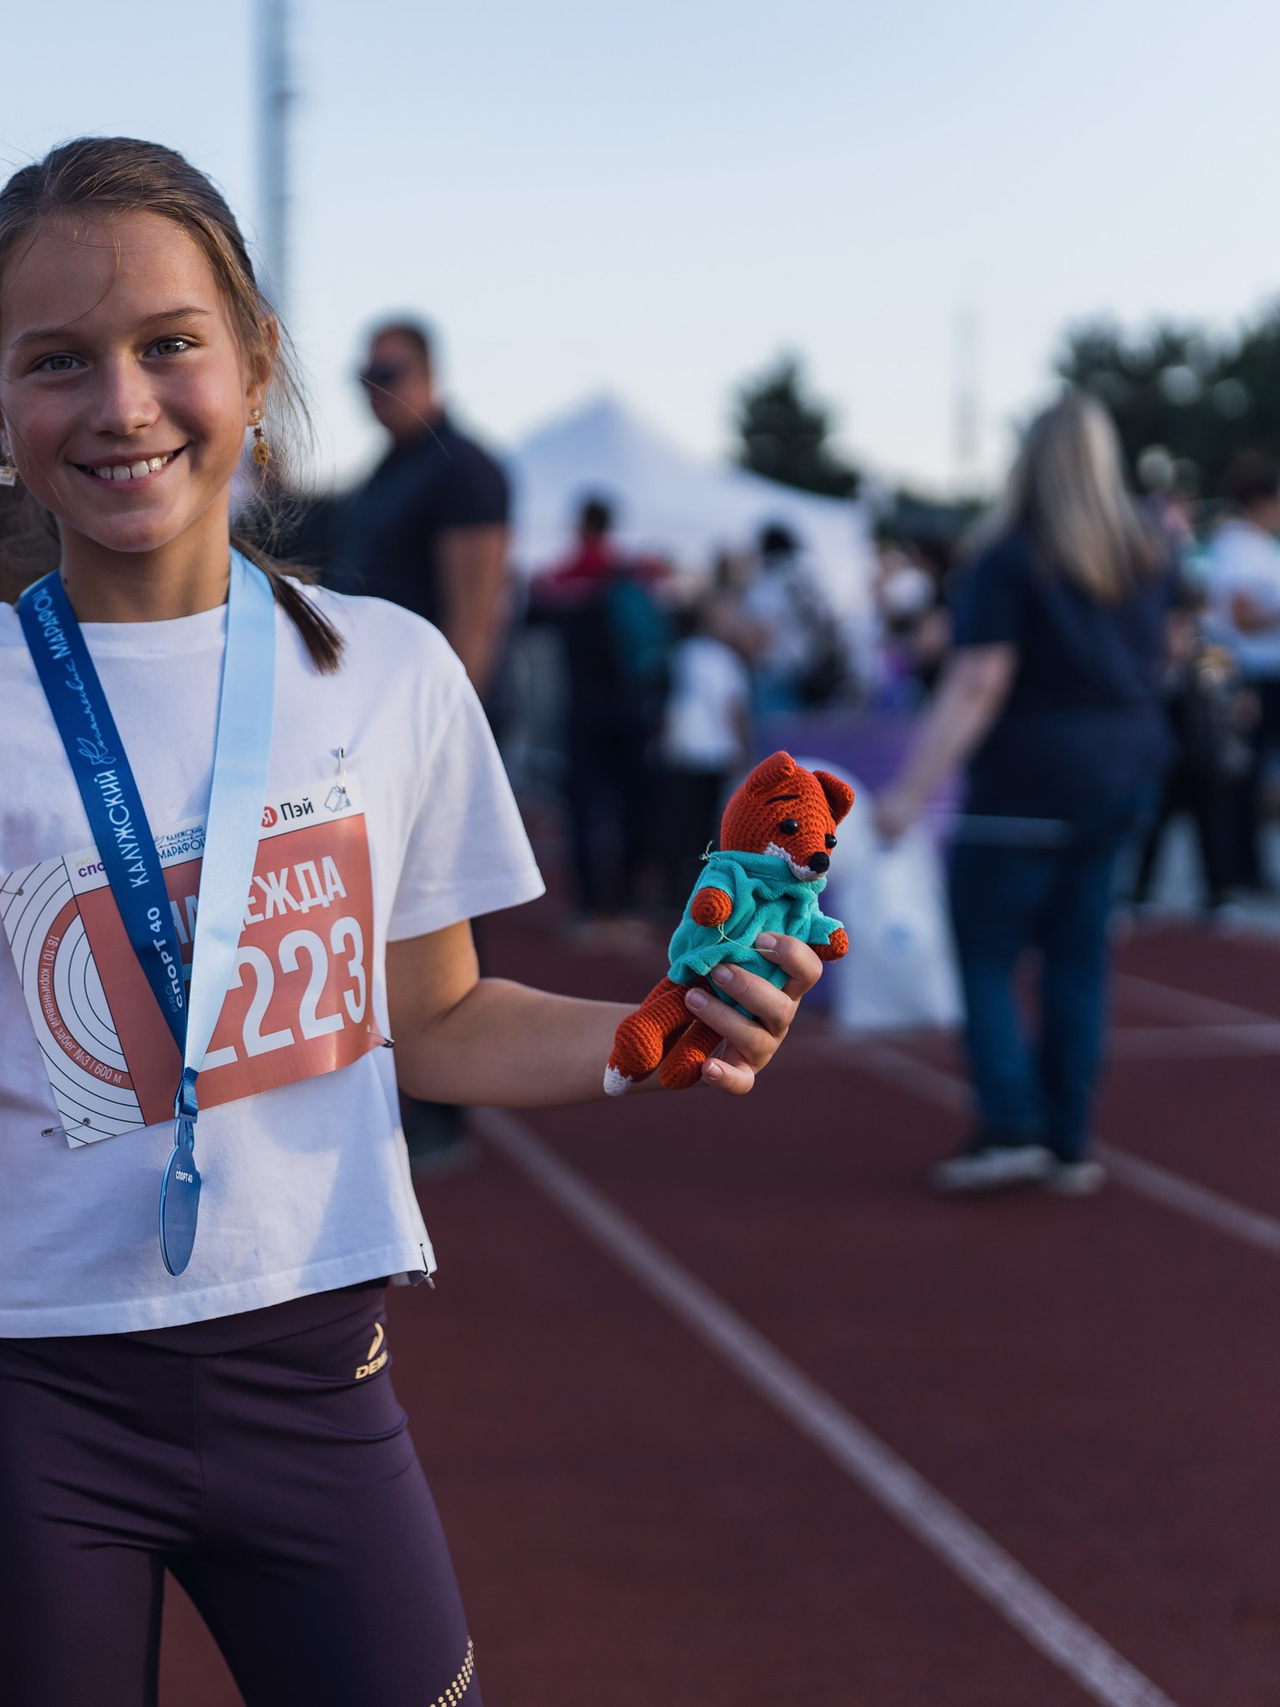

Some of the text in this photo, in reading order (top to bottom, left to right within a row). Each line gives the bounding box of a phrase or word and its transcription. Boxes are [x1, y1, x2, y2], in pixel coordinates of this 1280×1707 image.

[280, 797, 314, 821] Пэй
[94, 769, 150, 888] КАЛУЖСКИЙ
[146, 906, 162, 934] 40
[43, 934, 61, 961] 18:10
[39, 968, 61, 1028] коричневый
[55, 1027, 76, 1051] забег
[73, 1048, 90, 1067] №3
[94, 1064, 113, 1080] 600
